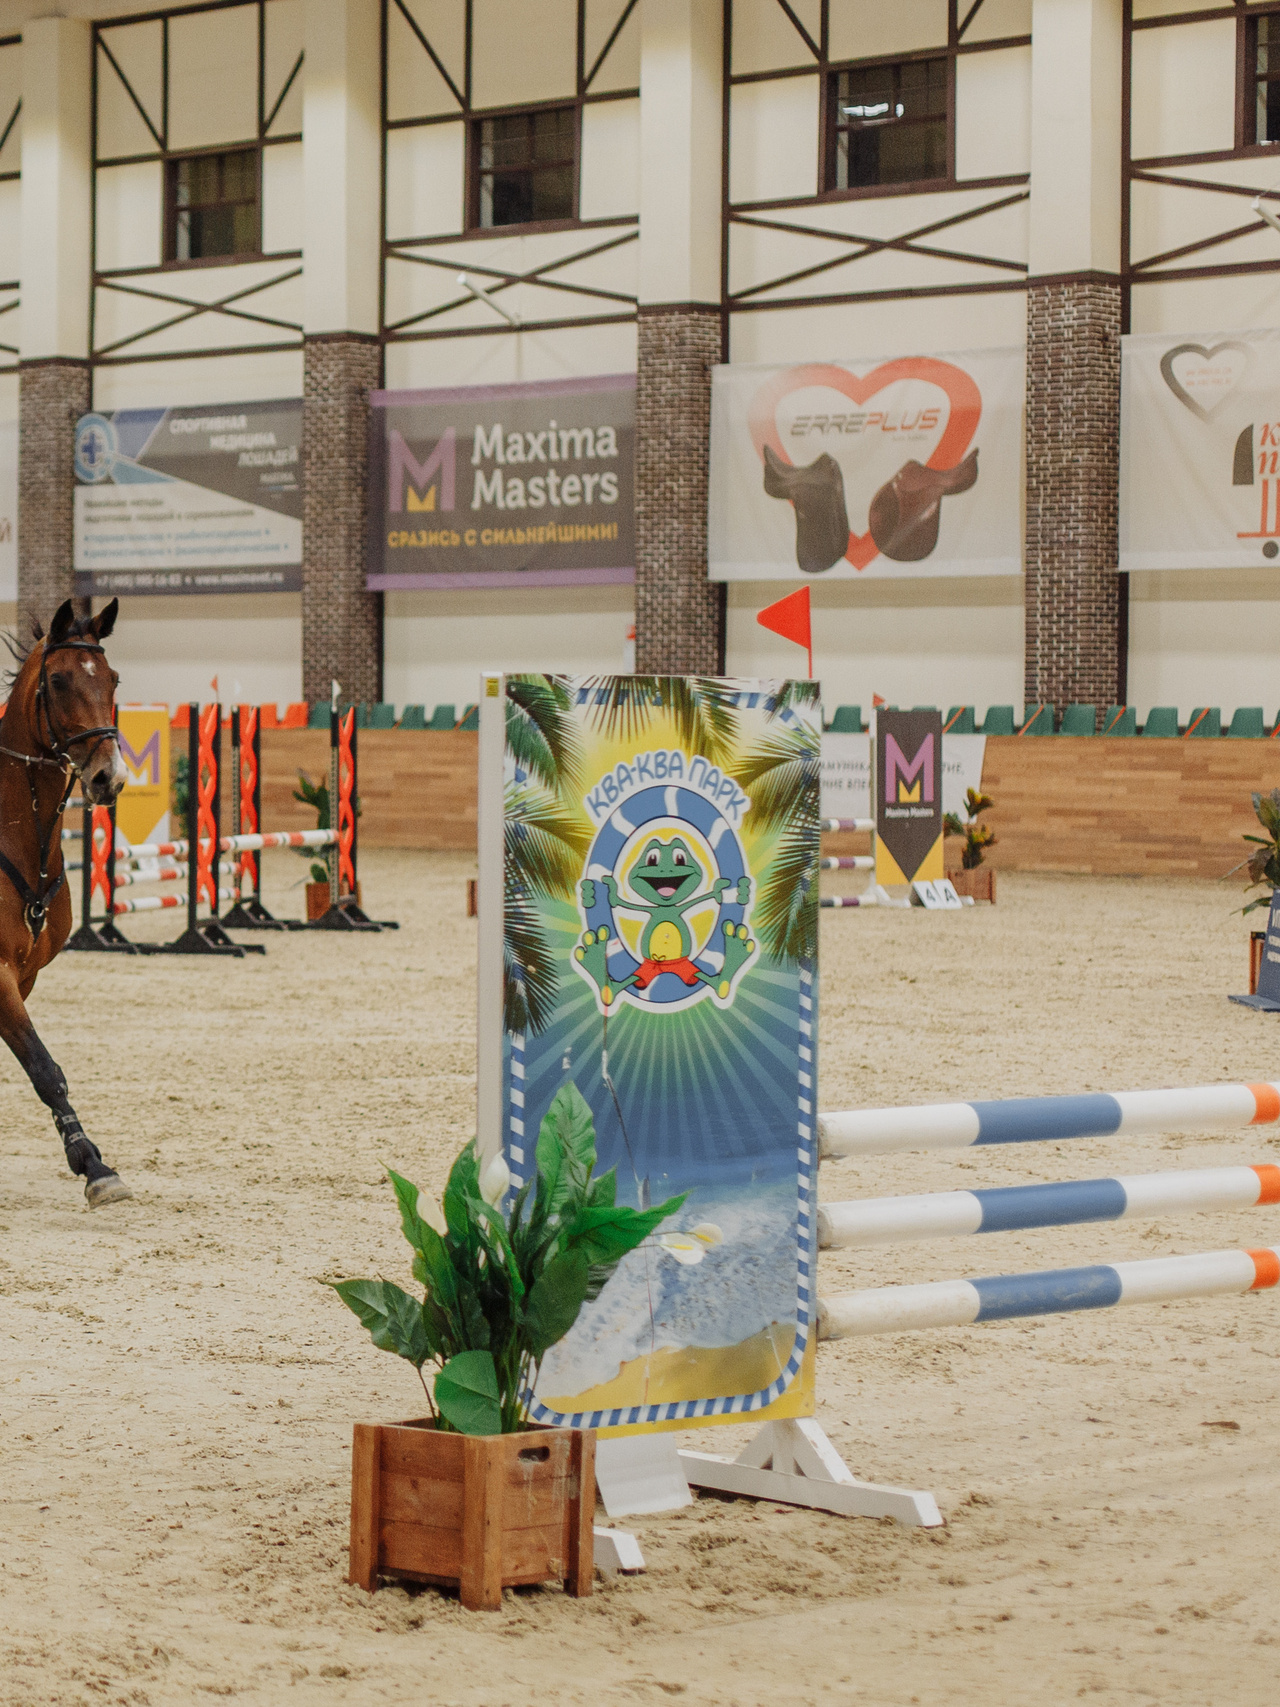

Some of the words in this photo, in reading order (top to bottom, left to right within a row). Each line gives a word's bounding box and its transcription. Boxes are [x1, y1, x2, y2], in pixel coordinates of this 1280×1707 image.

[471, 419, 618, 466] Maxima
[790, 408, 941, 437] ERREPLUS
[471, 468, 619, 511] Masters
[387, 530, 461, 548] СРАЗИСЬ
[464, 529, 477, 545] С
[587, 750, 684, 818] КВА-КВА
[687, 754, 746, 821] ПАРК
